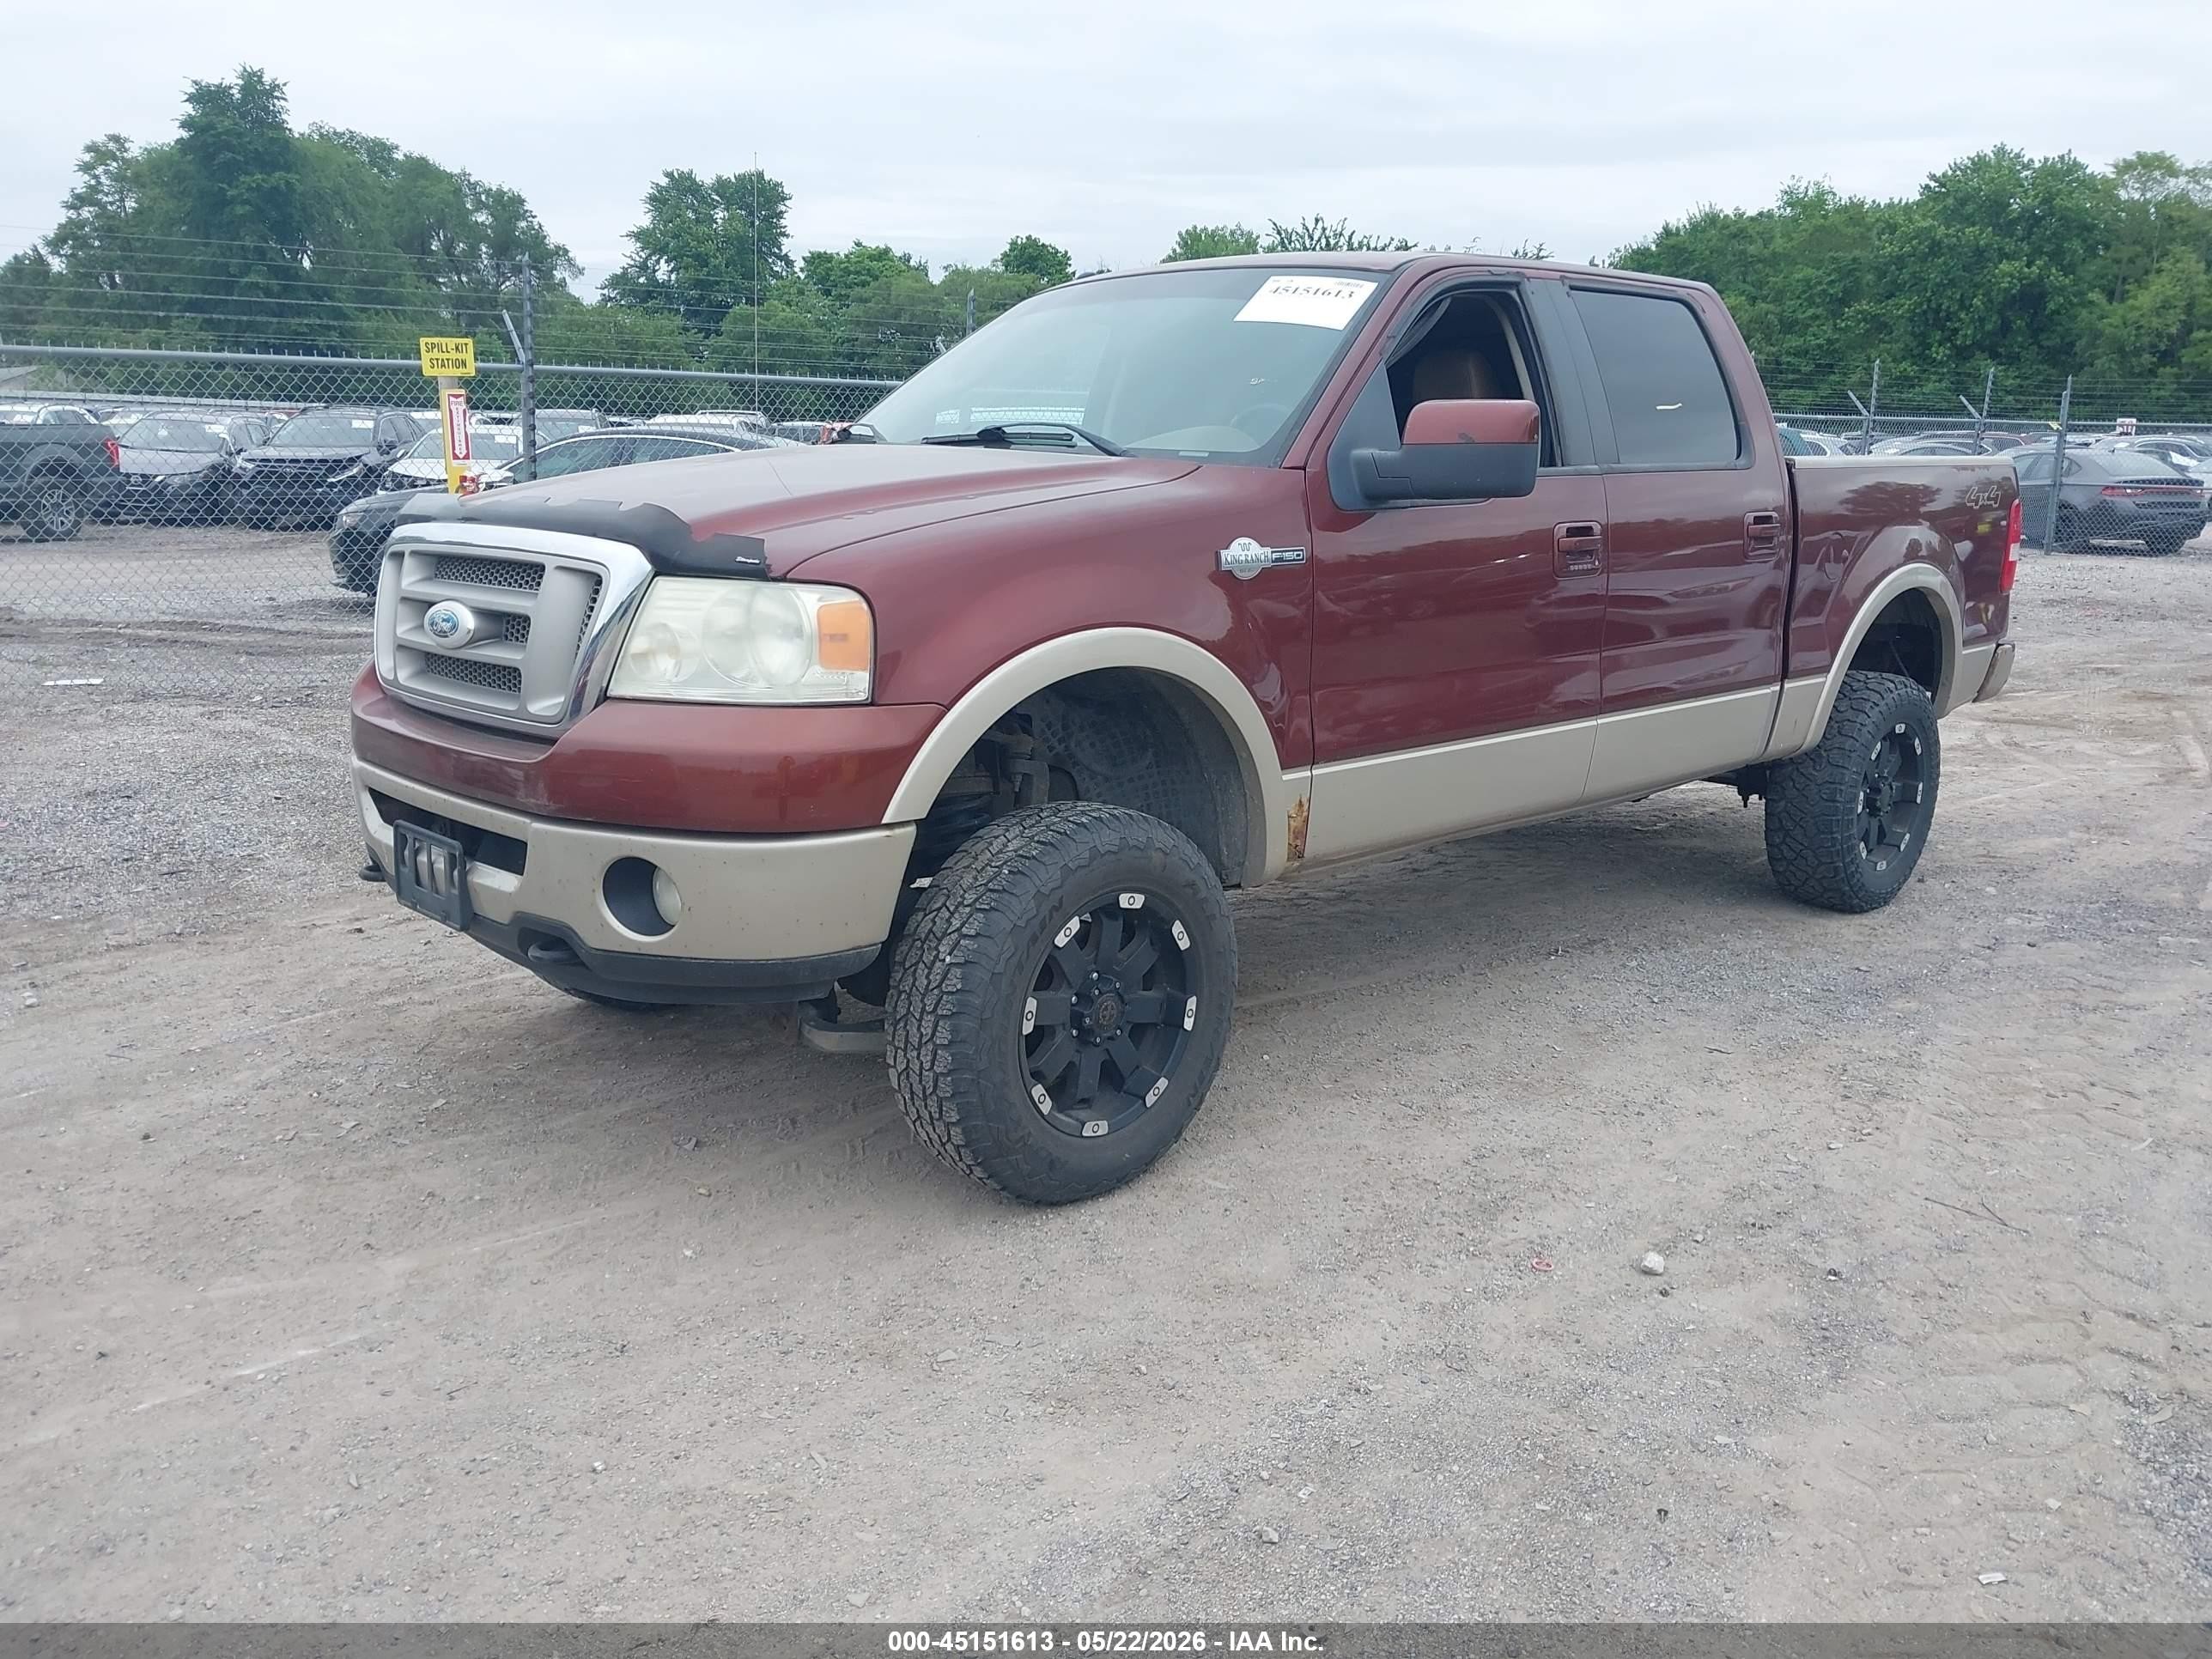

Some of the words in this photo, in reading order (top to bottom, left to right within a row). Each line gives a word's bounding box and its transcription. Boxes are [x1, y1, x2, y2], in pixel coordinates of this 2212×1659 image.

[424, 342, 469, 354] SPILL-KIT
[428, 358, 467, 369] STATION
[1224, 552, 1243, 566] KING
[1244, 550, 1269, 564] RANCH
